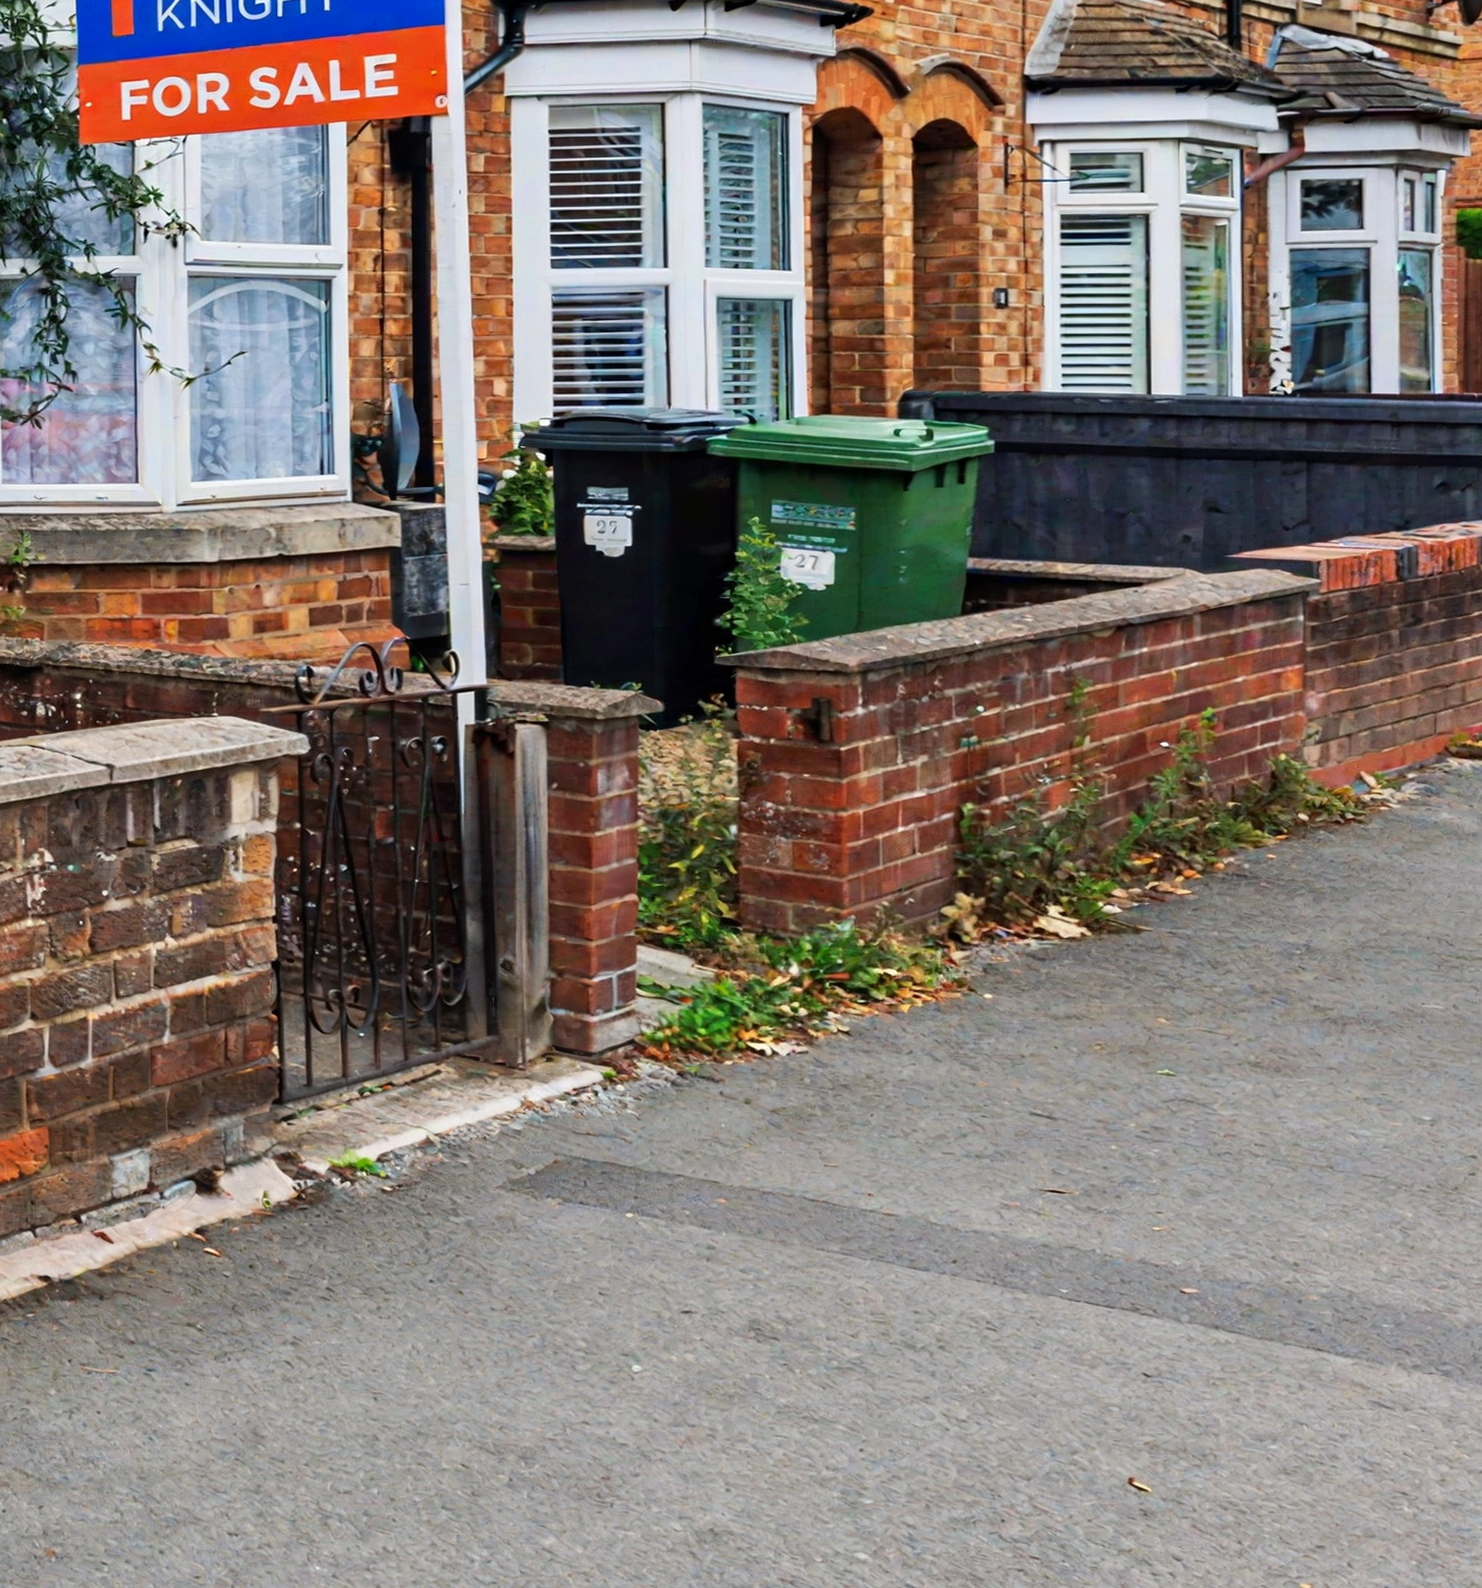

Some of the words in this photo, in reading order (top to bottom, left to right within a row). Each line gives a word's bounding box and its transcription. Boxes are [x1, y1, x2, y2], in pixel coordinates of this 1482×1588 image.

[120, 72, 230, 120] FOR
[249, 53, 399, 107] SALE
[596, 519, 618, 534] 27
[791, 553, 819, 571] 27
